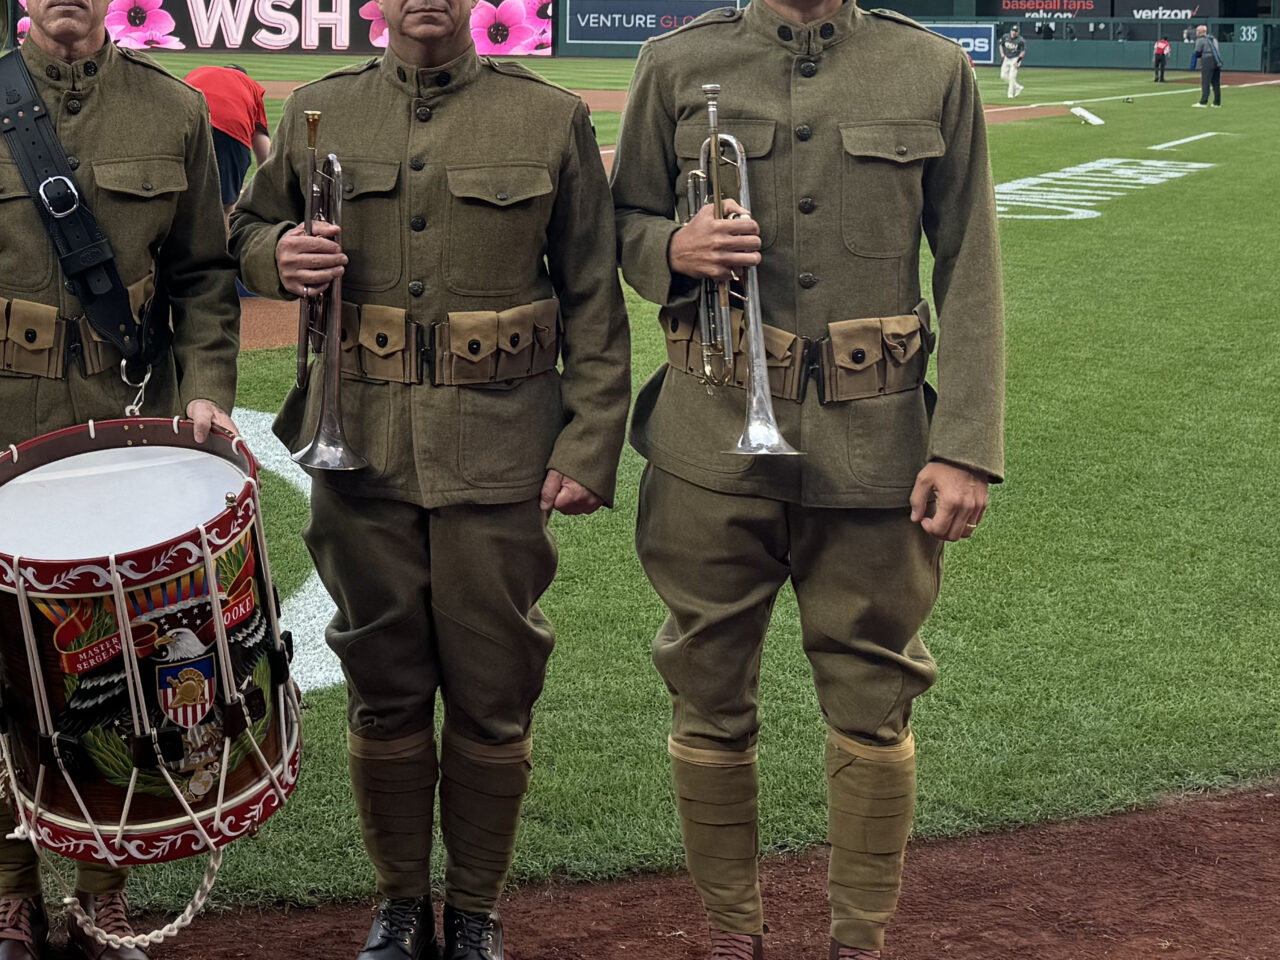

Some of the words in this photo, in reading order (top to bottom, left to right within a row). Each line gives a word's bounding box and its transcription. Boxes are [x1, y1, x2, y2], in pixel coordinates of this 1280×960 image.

[1024, 9, 1052, 18] rely
[1132, 5, 1192, 19] verizon
[576, 13, 657, 28] VENTURE
[1239, 25, 1258, 42] 335
[78, 636, 119, 661] MASTER
[76, 642, 122, 672] SERGEAN
